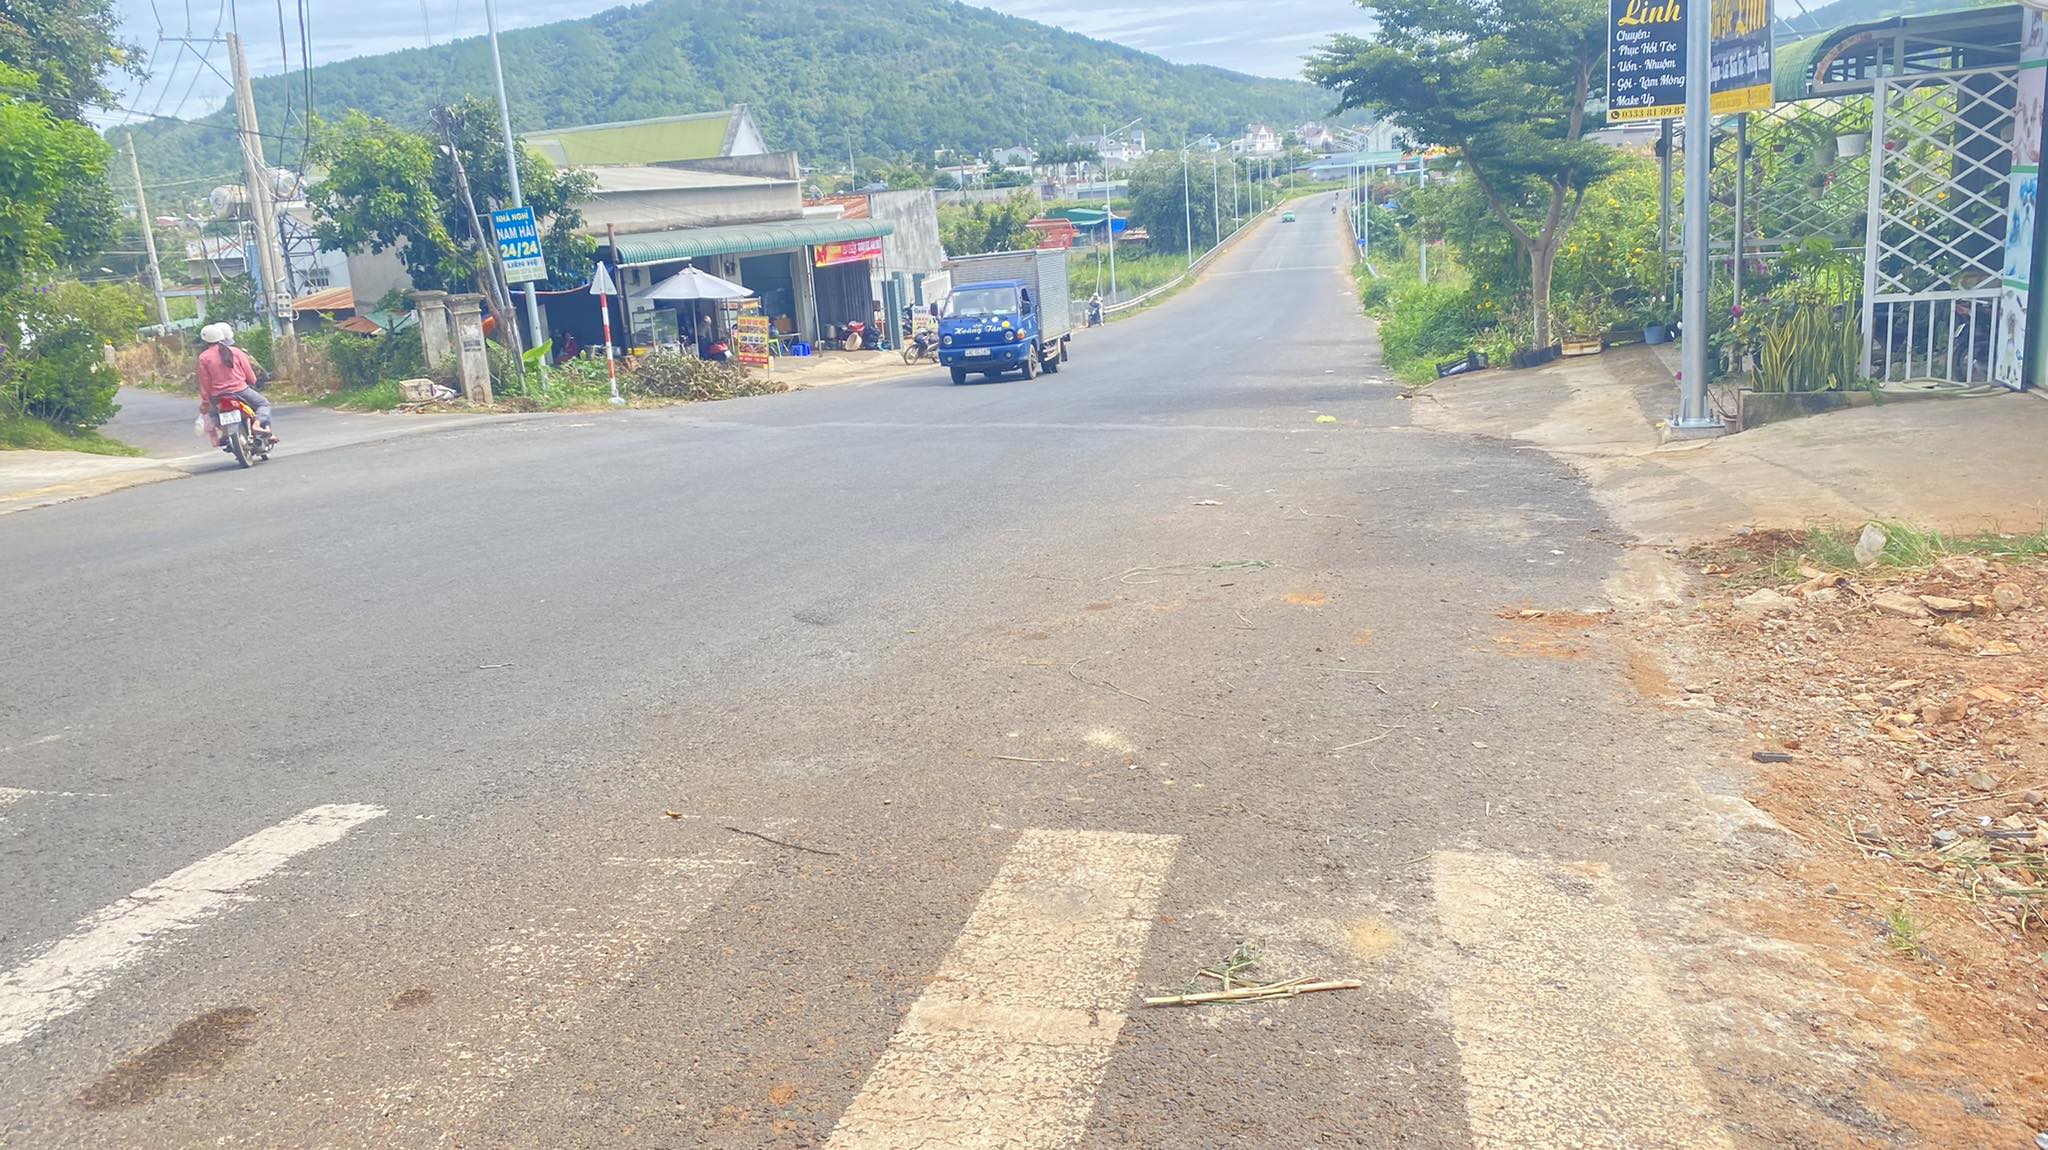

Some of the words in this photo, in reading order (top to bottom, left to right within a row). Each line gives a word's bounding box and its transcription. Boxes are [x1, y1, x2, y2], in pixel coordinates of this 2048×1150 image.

[1617, 0, 1682, 26] Linh
[1616, 95, 1640, 107] Make
[1641, 93, 1655, 107] Up
[495, 213, 511, 223] NHÀ
[496, 226, 518, 241] NAM
[500, 240, 538, 258] 24/24
